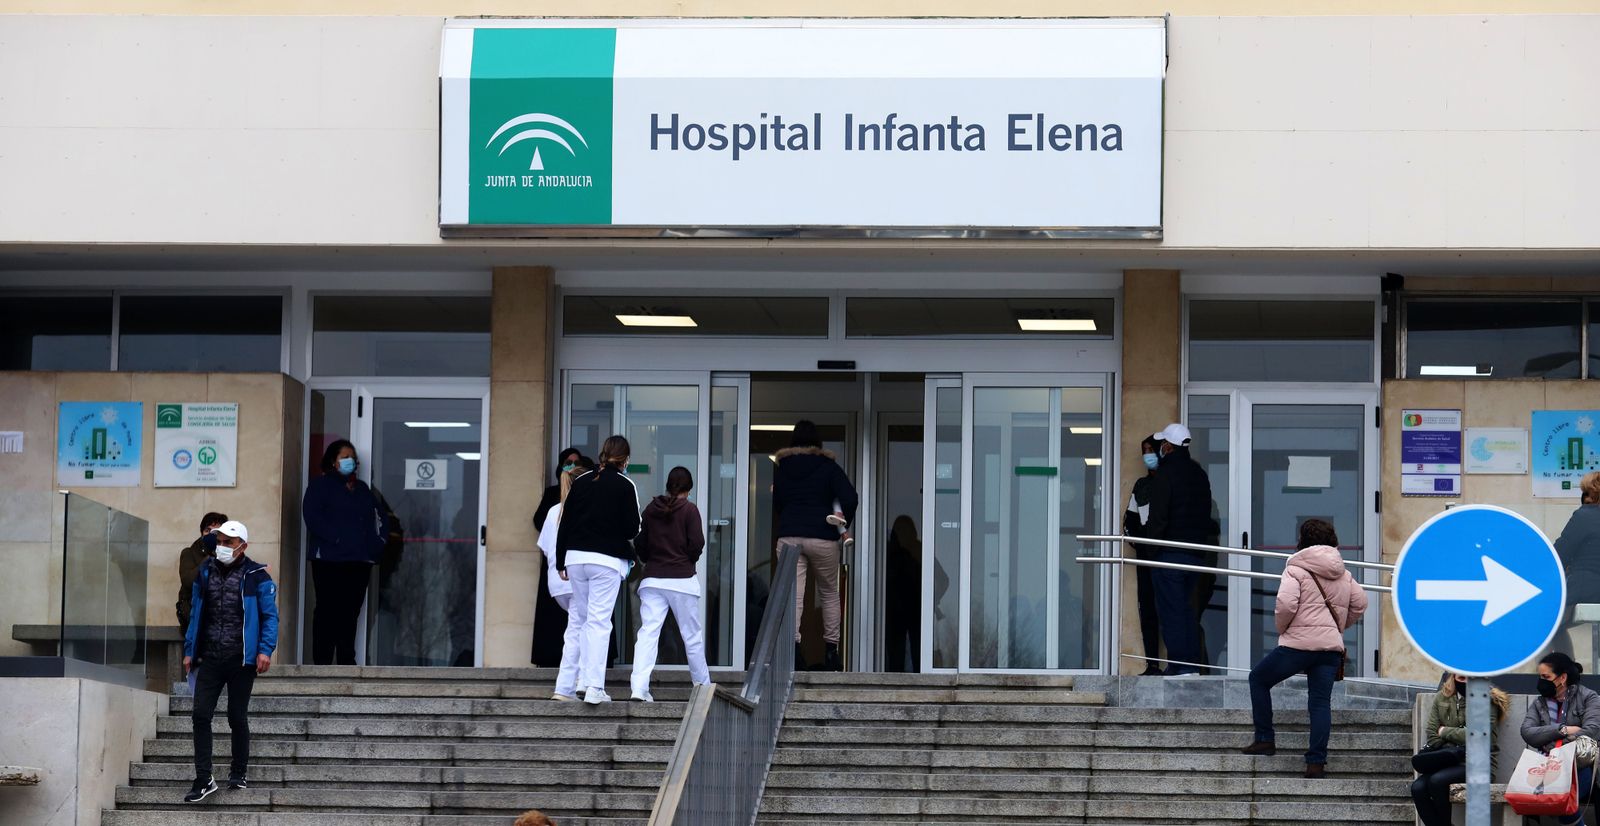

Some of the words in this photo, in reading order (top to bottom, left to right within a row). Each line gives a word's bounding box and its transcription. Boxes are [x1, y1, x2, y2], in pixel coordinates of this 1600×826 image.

[650, 112, 822, 161] Hospital
[844, 112, 986, 152] Infanta
[1007, 112, 1123, 152] Elena
[485, 175, 517, 187] JUNTA
[521, 175, 534, 187] DE
[538, 175, 593, 187] ANDALUCIA
